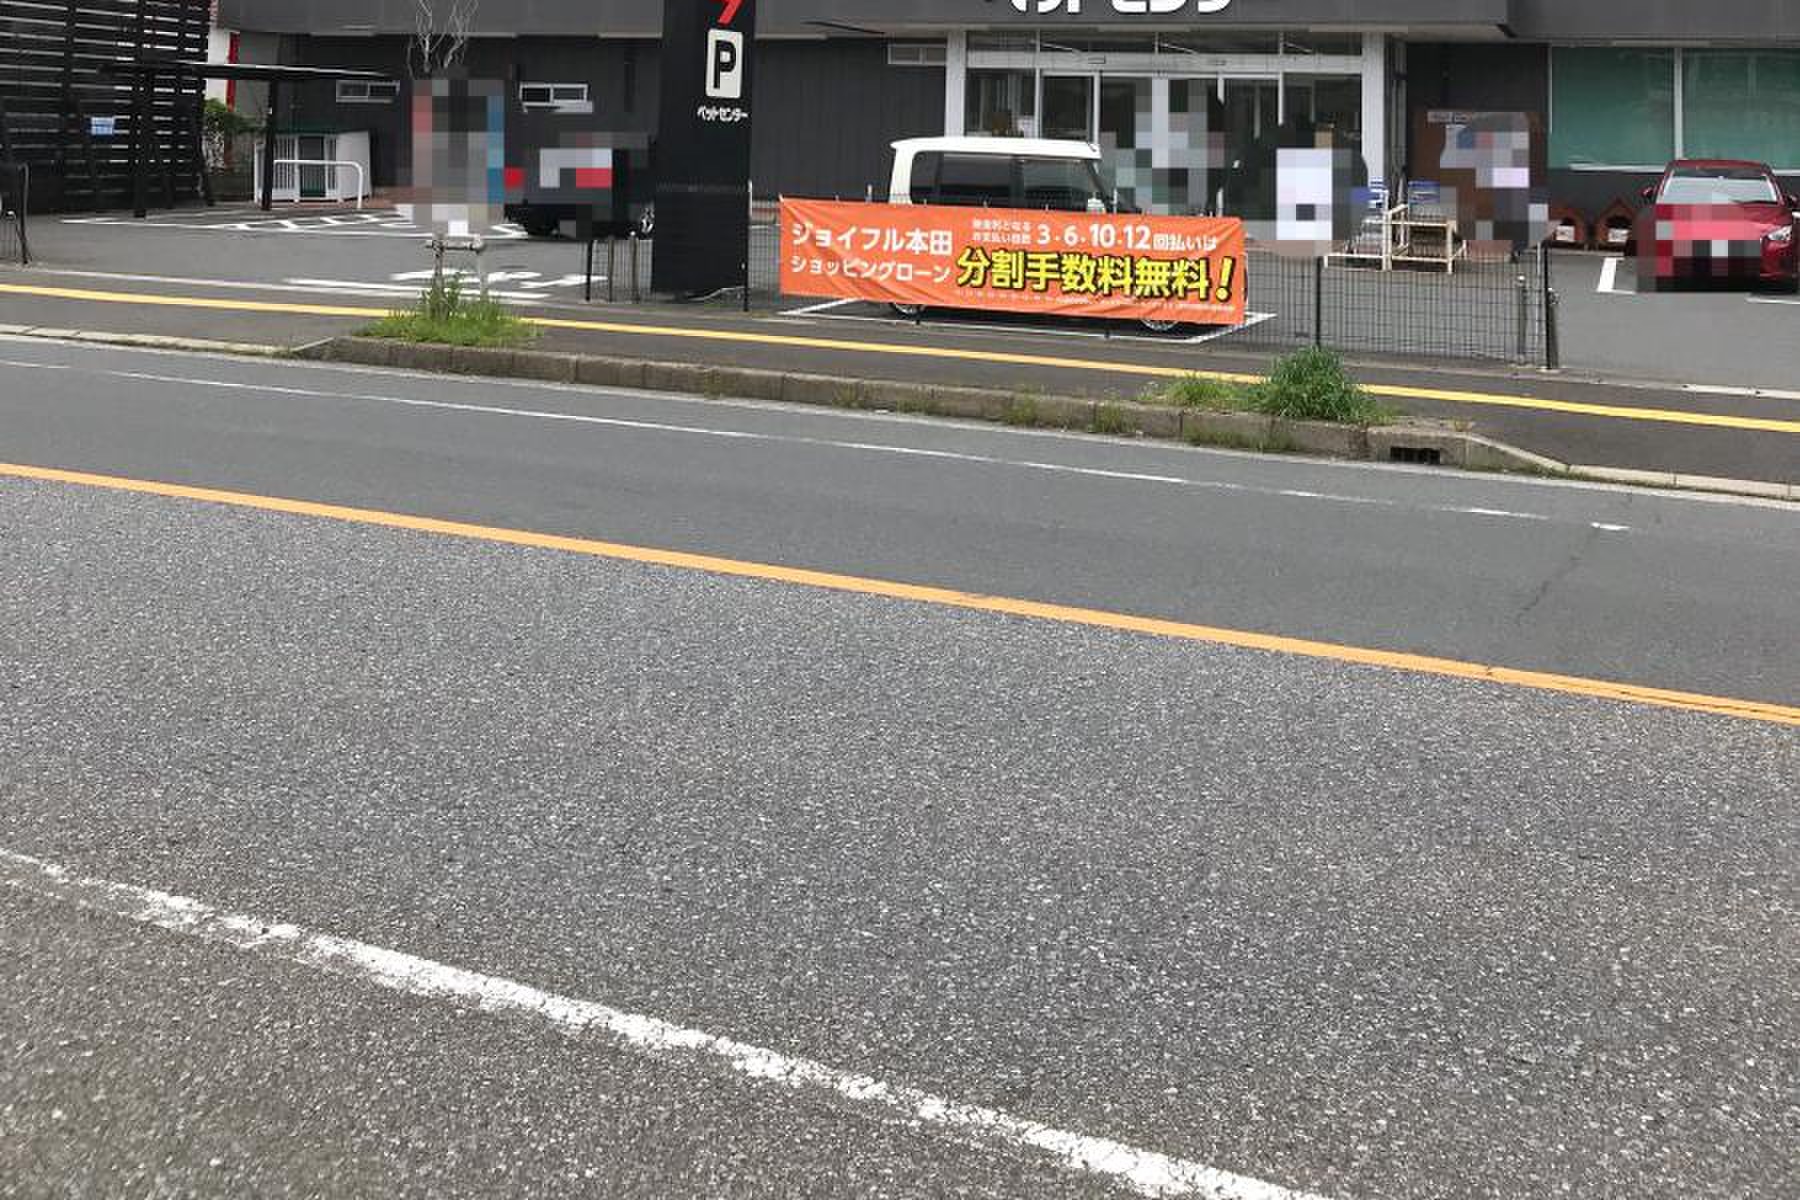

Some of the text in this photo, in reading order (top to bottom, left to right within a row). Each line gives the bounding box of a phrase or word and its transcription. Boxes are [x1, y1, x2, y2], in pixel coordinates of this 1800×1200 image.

[713, 40, 737, 89] P
[697, 105, 748, 122] ペットセンター
[791, 220, 953, 256] ジョイフル本田
[791, 255, 951, 284] ショッピングローン
